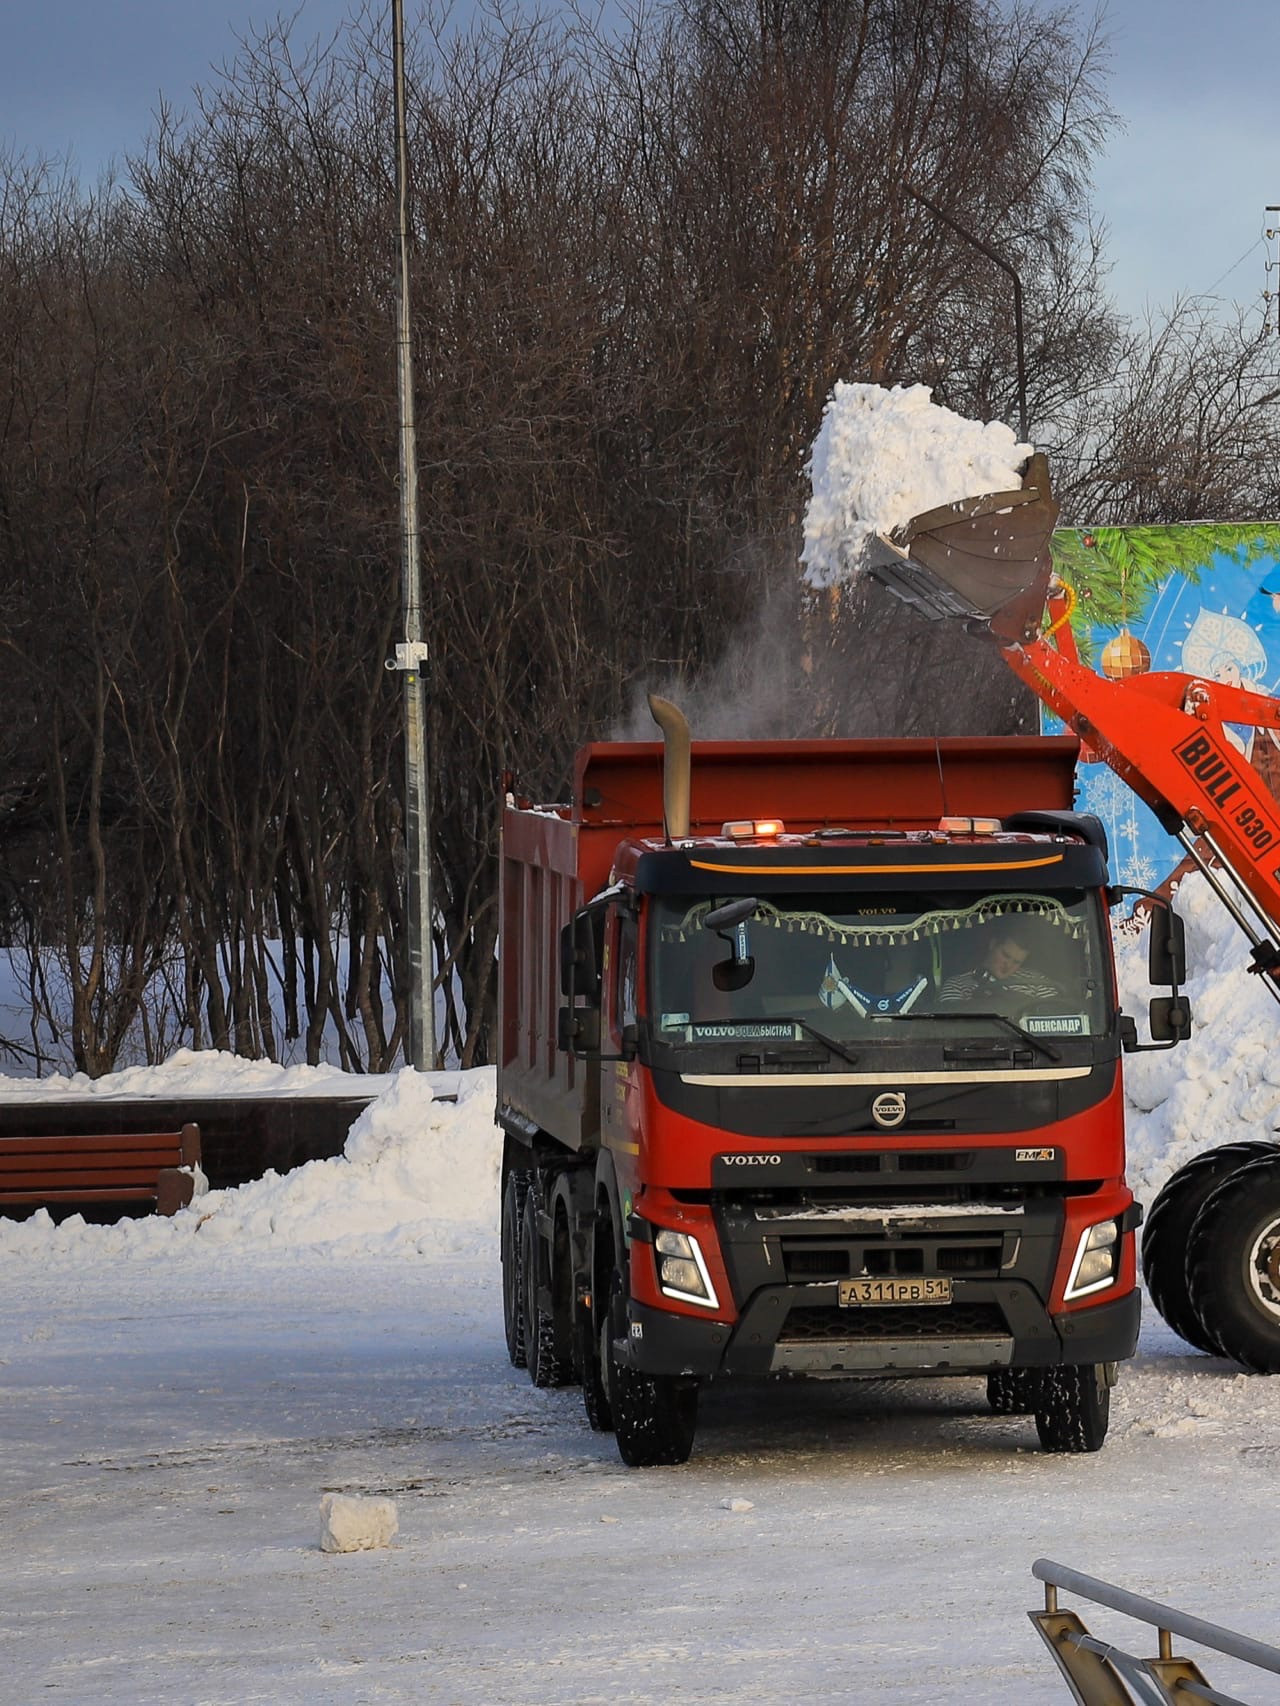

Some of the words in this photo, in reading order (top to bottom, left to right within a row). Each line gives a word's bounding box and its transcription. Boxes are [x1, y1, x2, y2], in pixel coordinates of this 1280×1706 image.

[1180, 735, 1242, 809] BULL
[1235, 807, 1273, 849] 930
[858, 907, 897, 916] VOLVO
[695, 1026, 736, 1037] VOLVO
[760, 1025, 792, 1037] БЫСТРАЯ
[1029, 1018, 1081, 1033] АЛЕКСАНДР
[874, 1105, 905, 1114] VOLVO
[721, 1154, 782, 1166] VOLVO
[848, 1282, 921, 1301] А311РВ
[926, 1280, 944, 1294] 51
